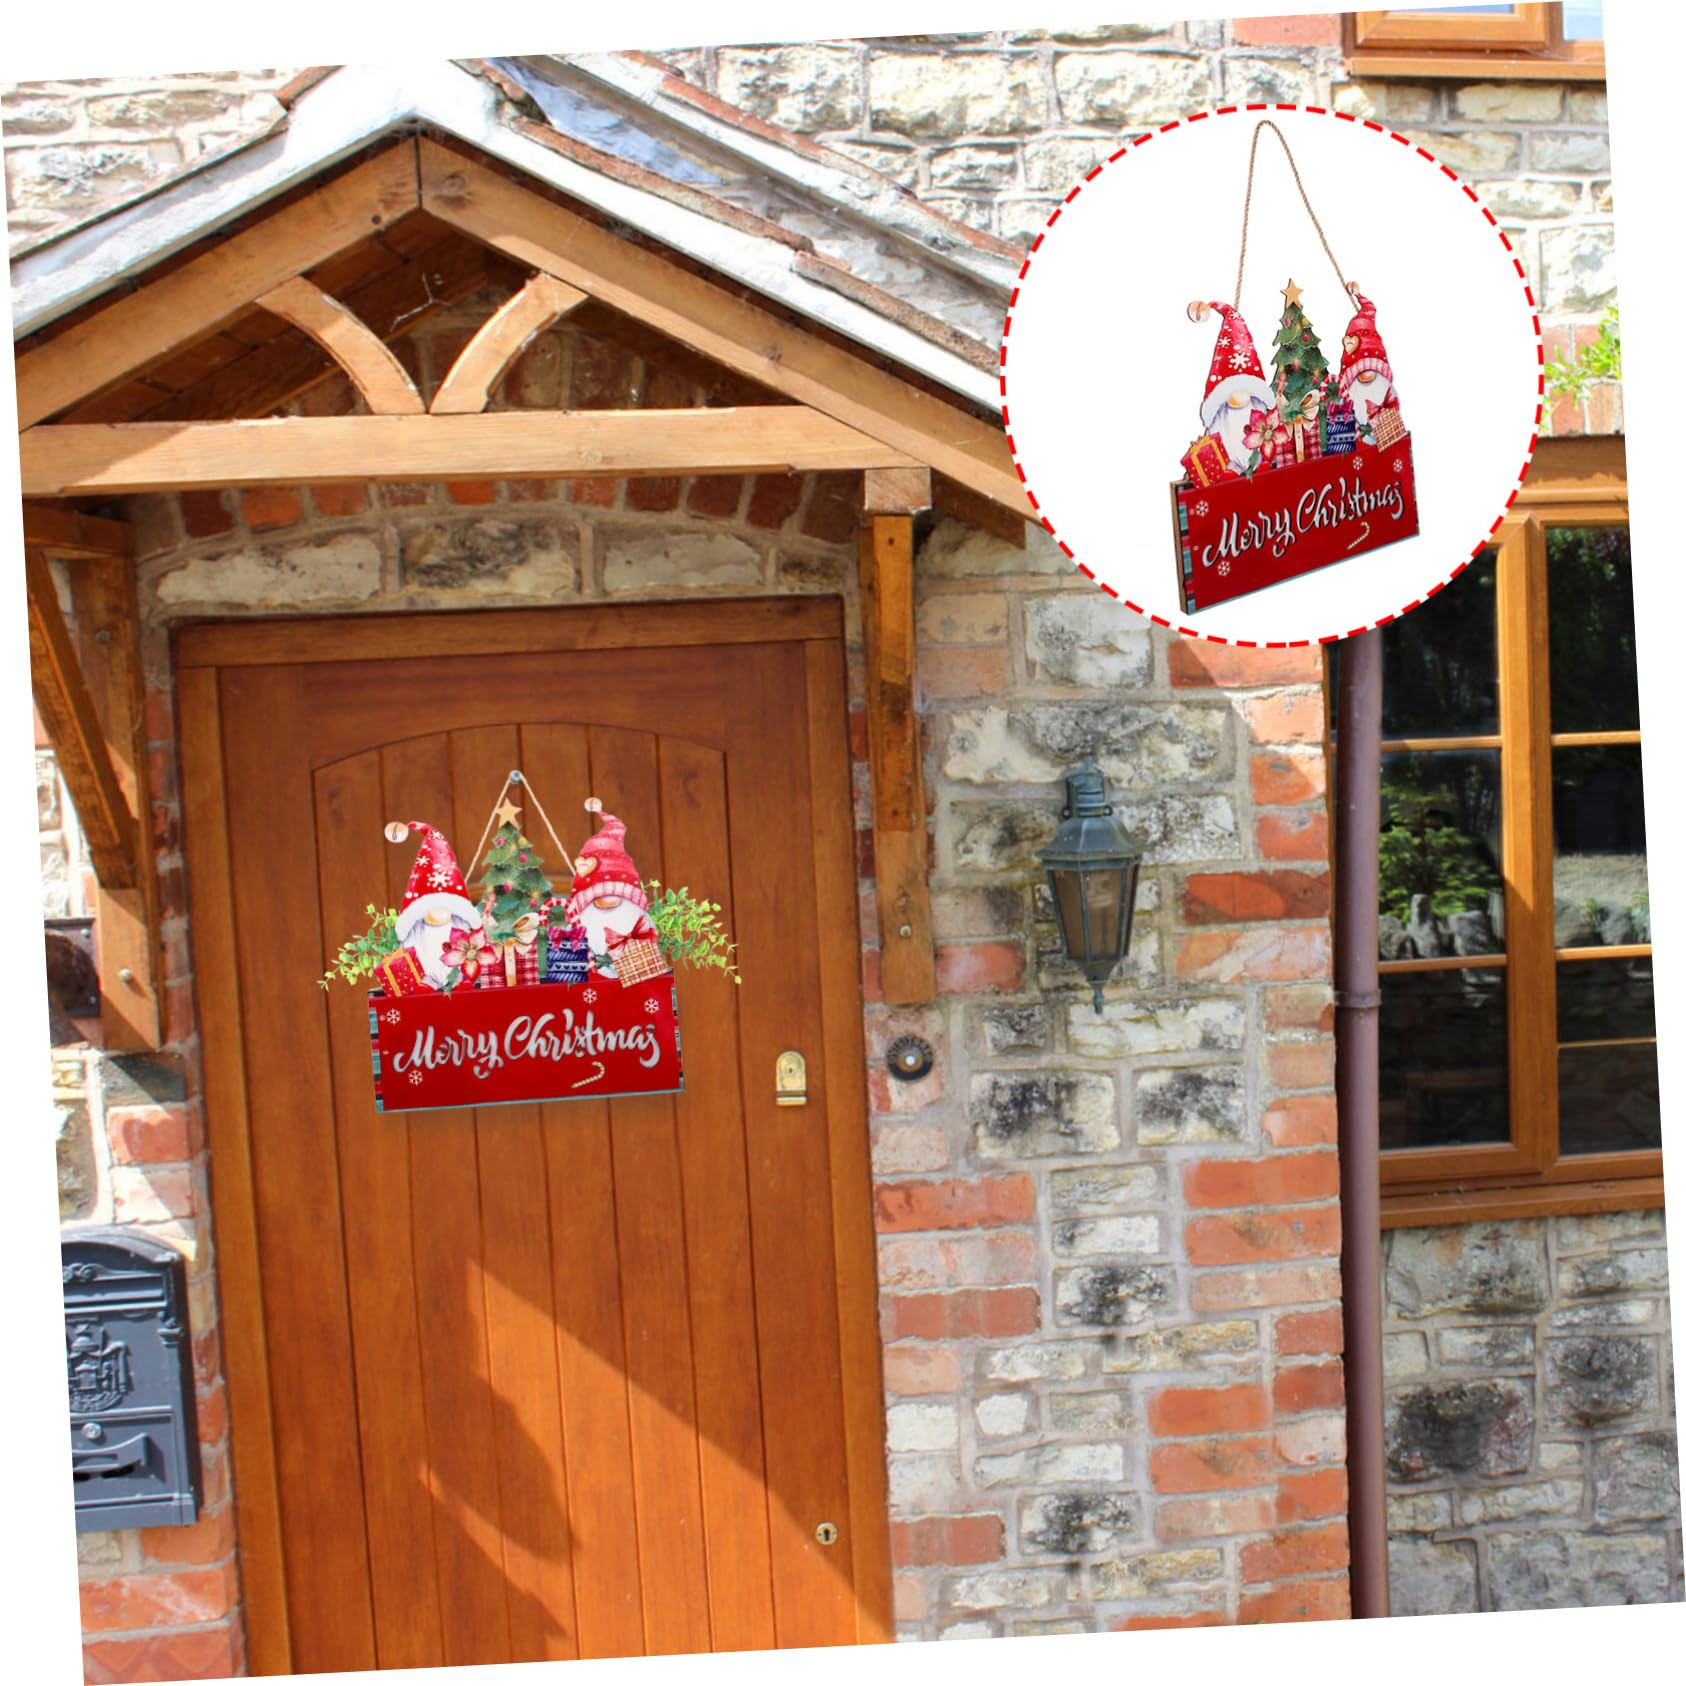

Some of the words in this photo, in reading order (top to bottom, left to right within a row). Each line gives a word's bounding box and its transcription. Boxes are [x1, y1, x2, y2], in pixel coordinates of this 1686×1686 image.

[1202, 510, 1296, 566] Merry
[1297, 477, 1404, 532] Christmas
[393, 1026, 503, 1079] Merry
[503, 1009, 660, 1069] Christmas
